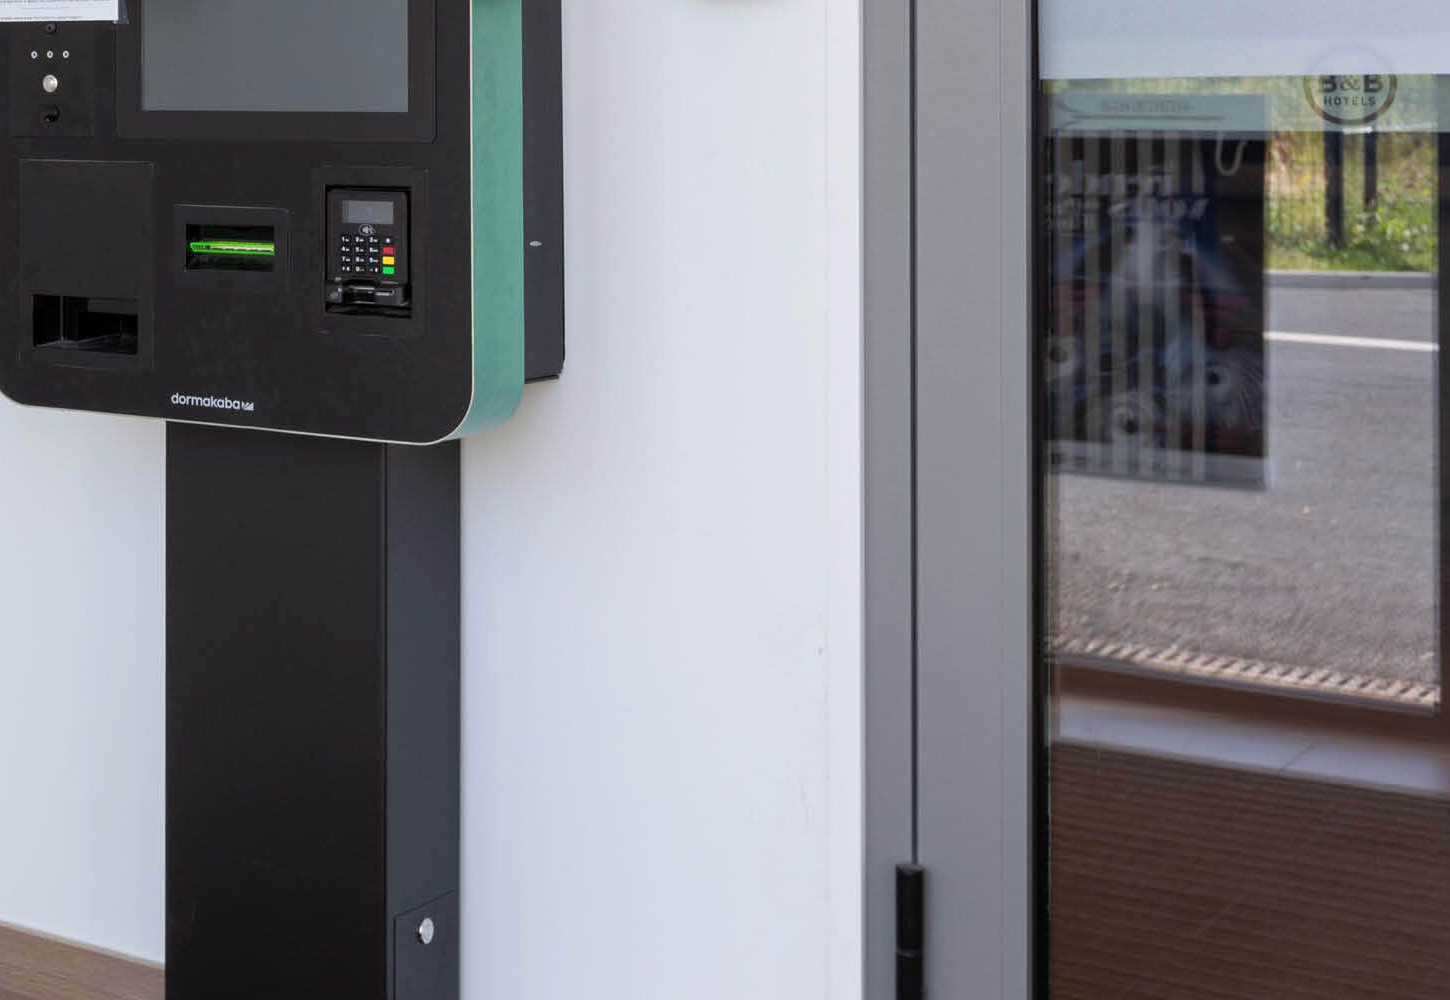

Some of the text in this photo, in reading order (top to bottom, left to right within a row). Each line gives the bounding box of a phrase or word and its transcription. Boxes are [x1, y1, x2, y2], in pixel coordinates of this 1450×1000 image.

[1319, 75, 1383, 93] B&B
[1324, 96, 1376, 106] HOTELS
[170, 392, 241, 411] dormakaba
